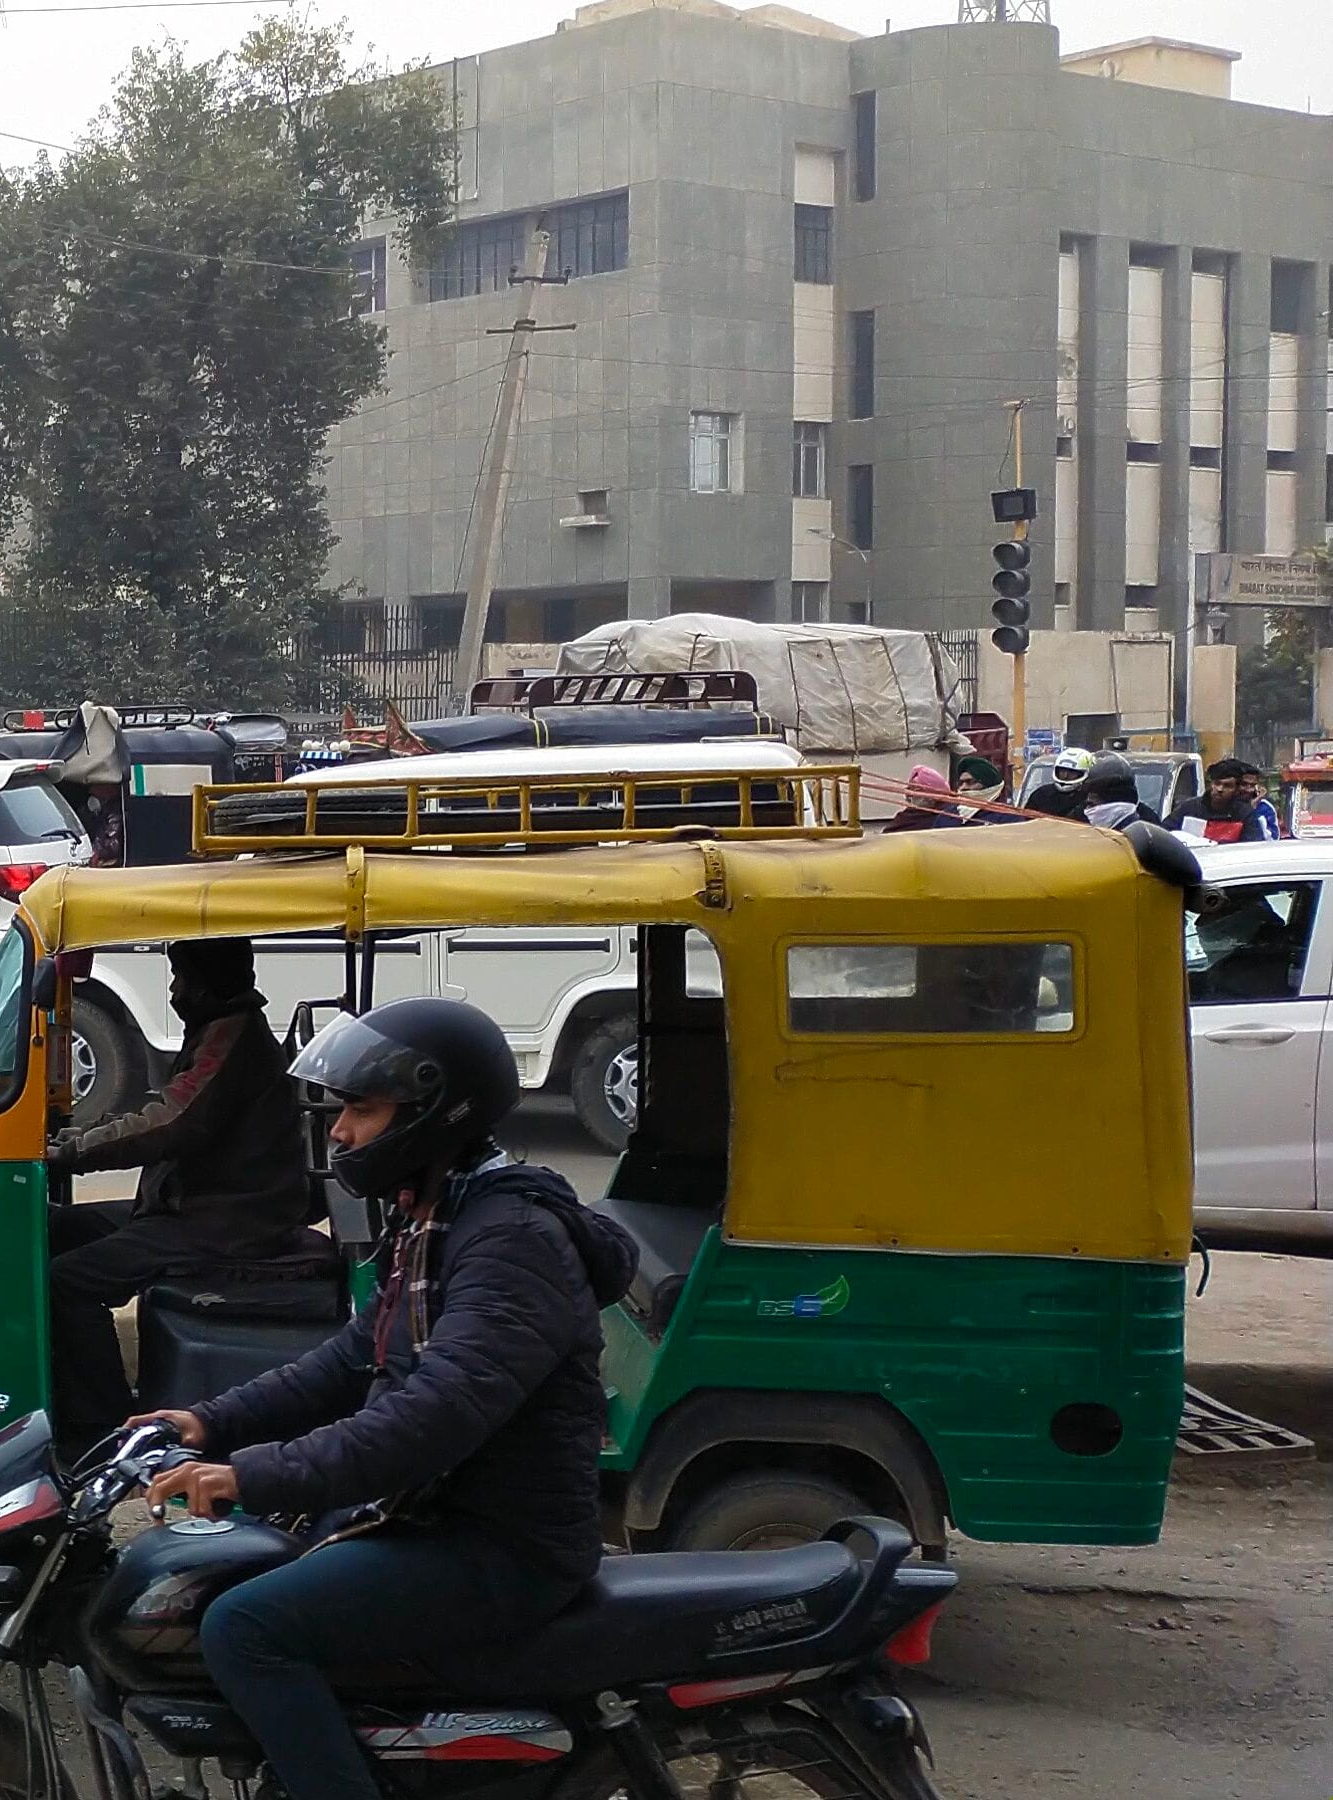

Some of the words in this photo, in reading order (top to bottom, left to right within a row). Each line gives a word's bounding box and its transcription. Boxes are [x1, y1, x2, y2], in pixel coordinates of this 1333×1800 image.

[756, 1294, 823, 1318] BS6
[421, 1712, 467, 1729] HF
[464, 1716, 553, 1731] Deluxe
